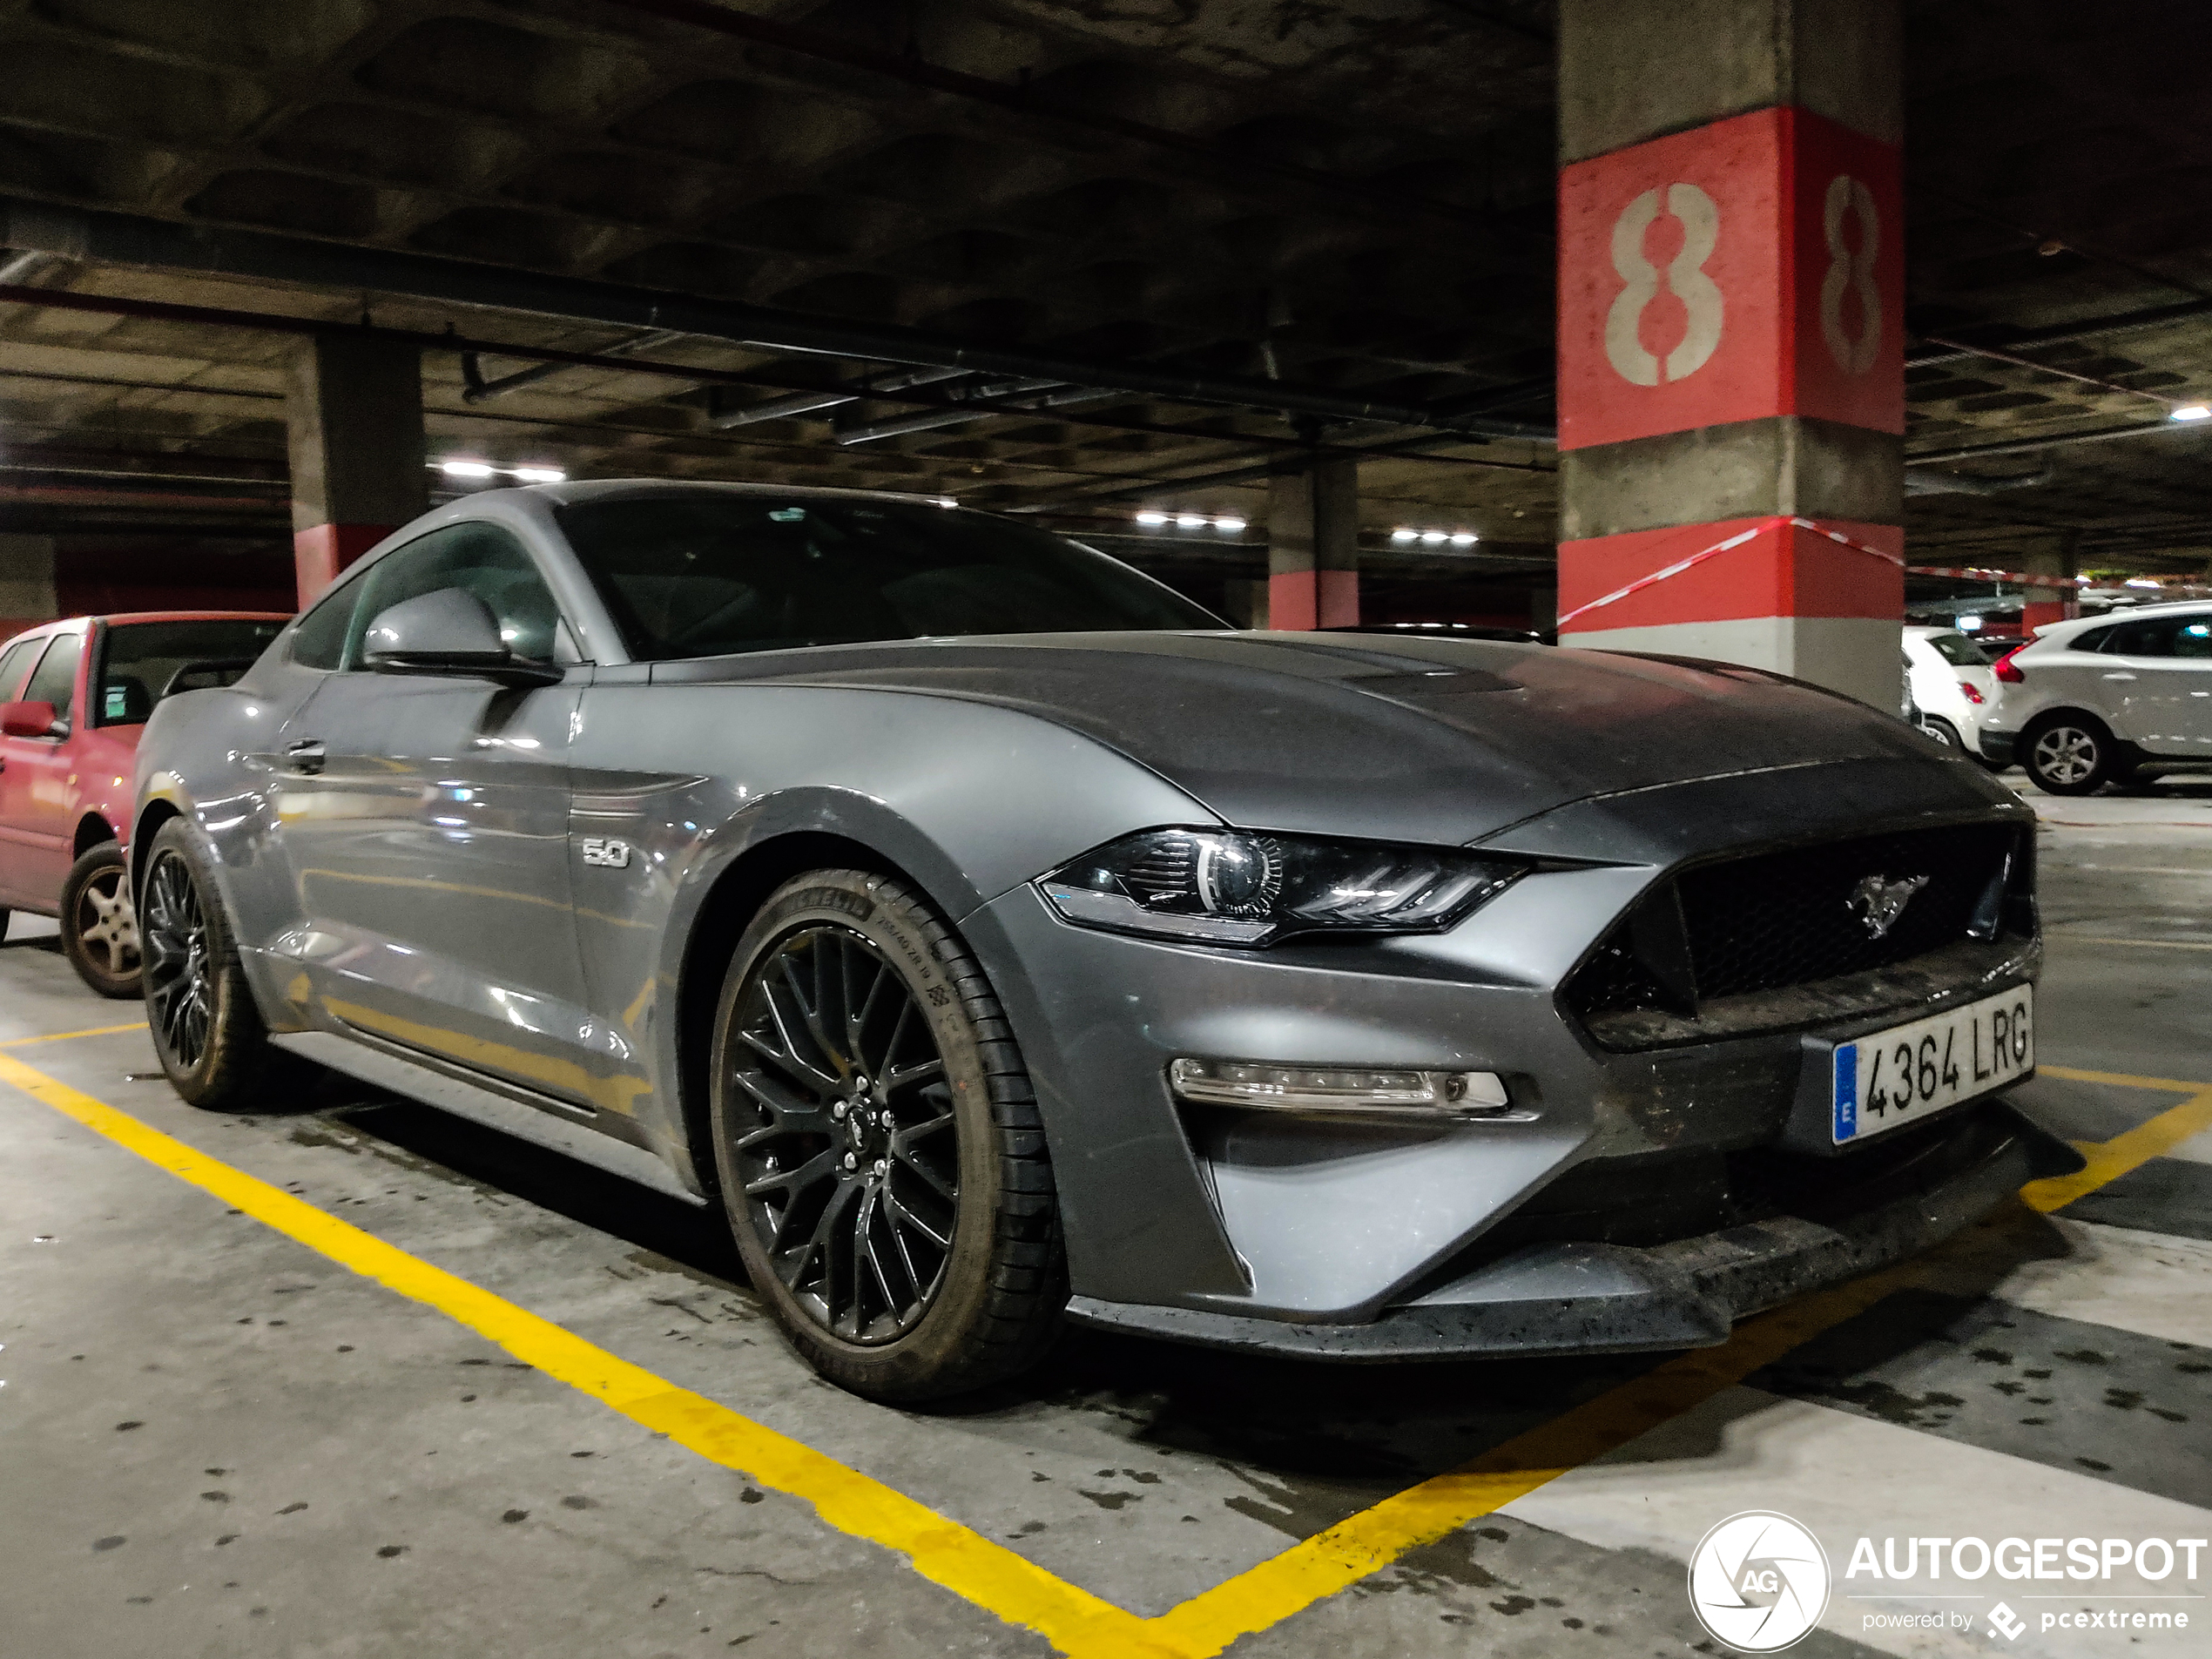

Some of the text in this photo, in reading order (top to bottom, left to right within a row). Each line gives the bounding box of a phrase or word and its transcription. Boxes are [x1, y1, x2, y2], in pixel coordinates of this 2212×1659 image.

[1604, 182, 1723, 387] 8
[1820, 174, 1883, 374] 8
[1842, 1101, 1852, 1123] E
[1866, 1002, 2027, 1118] 4364 LRG
